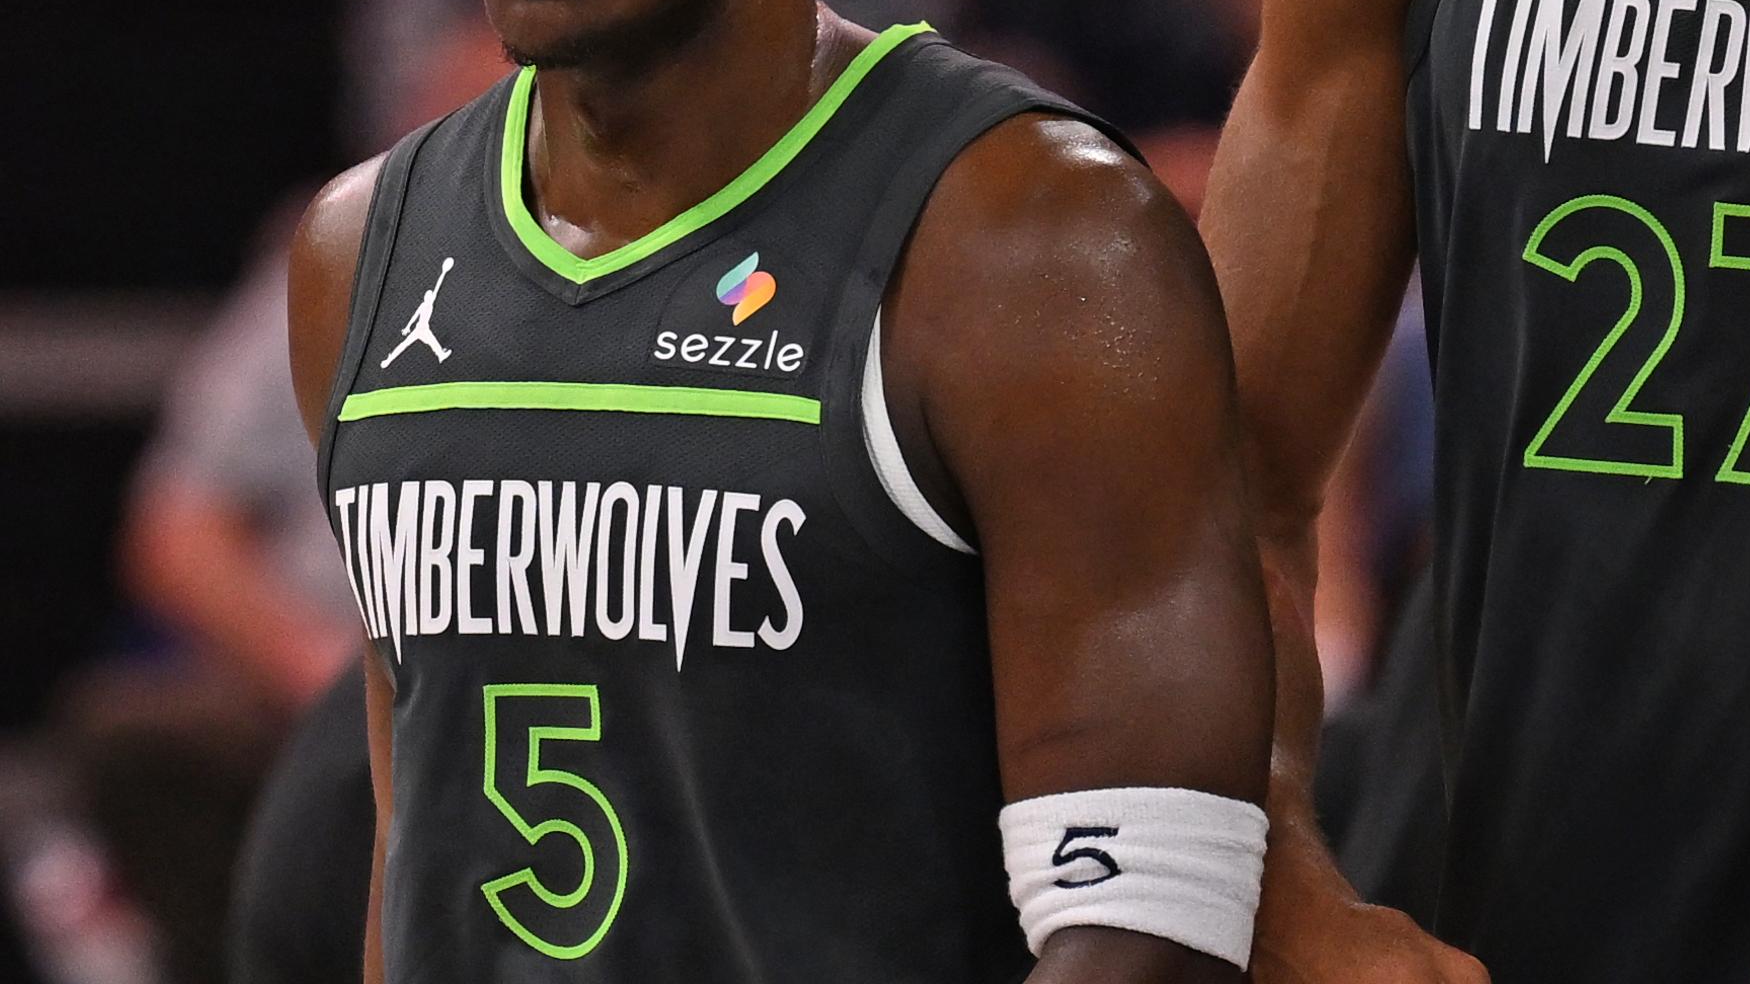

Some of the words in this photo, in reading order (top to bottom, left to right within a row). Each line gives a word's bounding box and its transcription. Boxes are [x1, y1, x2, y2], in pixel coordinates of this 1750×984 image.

[653, 329, 804, 372] sezzle
[336, 480, 807, 672] TIMBERWOLVES
[481, 683, 629, 960] 5
[1052, 827, 1122, 889] 5
